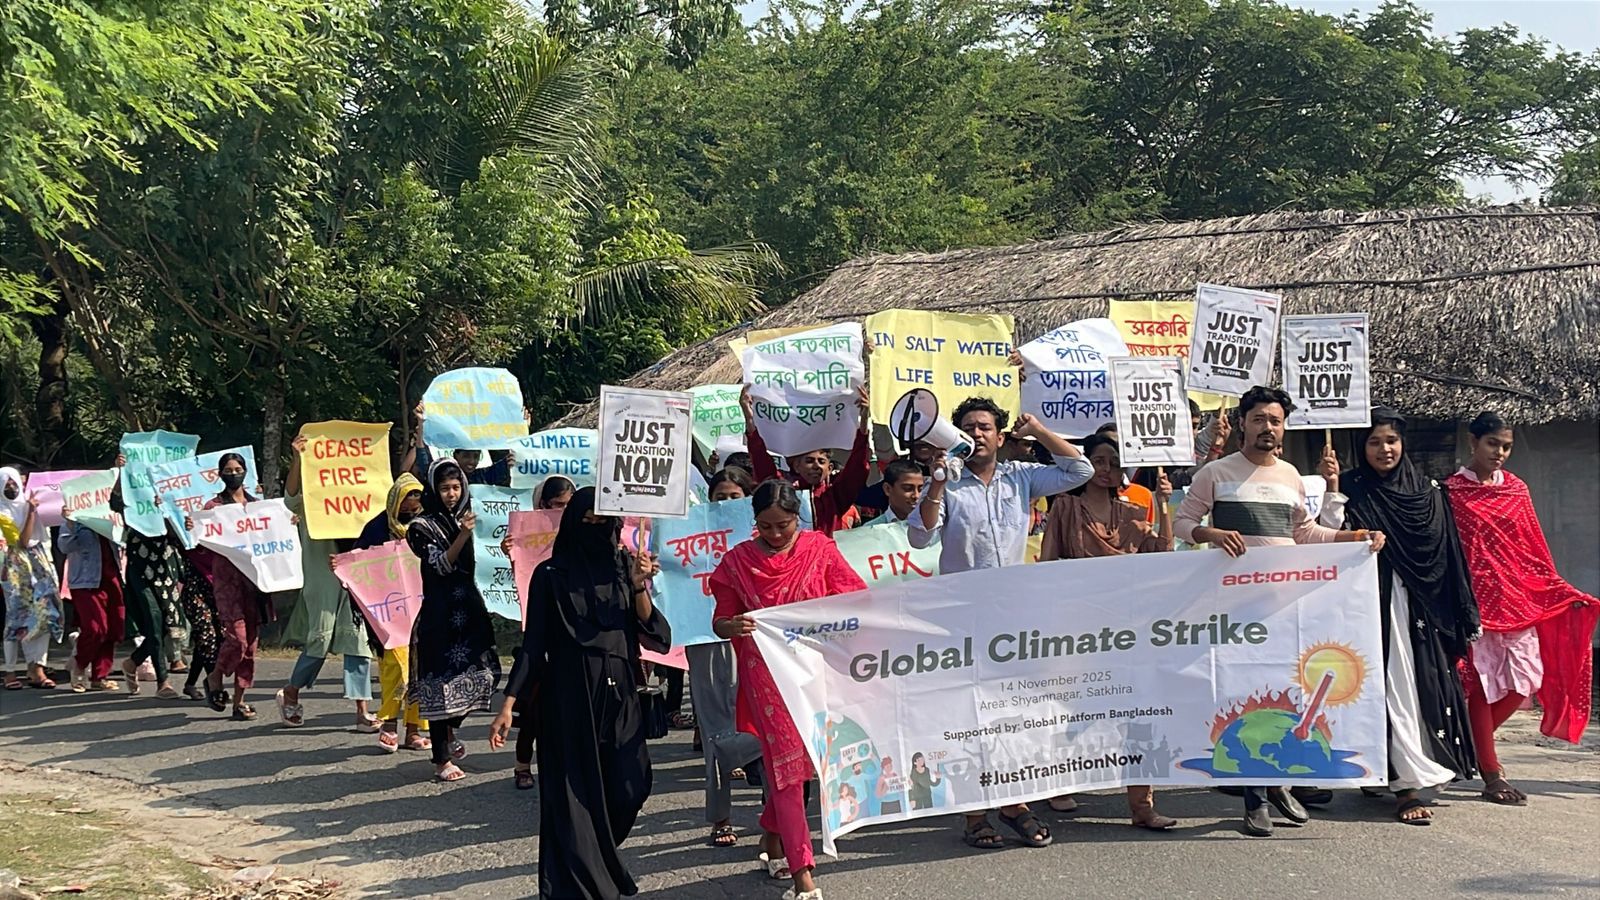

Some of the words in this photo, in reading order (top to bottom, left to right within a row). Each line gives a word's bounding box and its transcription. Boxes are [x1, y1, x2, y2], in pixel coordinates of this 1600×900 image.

[1208, 312, 1262, 336] JUST
[874, 332, 895, 348] IN
[905, 336, 946, 352] SALT
[1207, 332, 1260, 346] TRANSITION
[1203, 341, 1258, 370] NOW
[1298, 341, 1352, 363] JUST
[803, 362, 850, 390] পানি
[896, 367, 934, 384] LIFE
[953, 372, 1012, 387] BURNS
[1299, 364, 1353, 373] TRANSITION
[1040, 370, 1107, 390] আমার
[1299, 373, 1352, 398] NOW
[1128, 382, 1173, 402] JUST
[796, 404, 831, 426] হবে
[1041, 392, 1114, 420] অধিকার
[1129, 403, 1177, 412] TRANSITION
[615, 419, 675, 446] JUST
[1131, 413, 1176, 436] NOW
[126, 448, 144, 463] PAY
[147, 448, 160, 462] UP
[314, 437, 373, 460] CEASE
[616, 444, 675, 457] TRANSITION
[319, 466, 368, 487] FIRE
[518, 459, 591, 475] JUSTICE
[613, 455, 674, 485] NOW
[324, 494, 371, 515] NOW
[204, 523, 222, 537] IN
[236, 517, 271, 533] SALT
[253, 539, 294, 556] BURNS
[867, 551, 934, 580] FIX
[850, 636, 974, 683] Global
[988, 627, 1137, 663] Climate
[1150, 614, 1268, 647] Strike
[1000, 681, 1014, 693] 14
[1018, 675, 1077, 690] November
[1082, 671, 1112, 683] 2025
[980, 699, 1008, 712] Area:
[1011, 689, 1083, 707] Shyamnagar,
[1086, 684, 1133, 698] Satkhira
[944, 724, 1001, 742] Supported
[1004, 721, 1021, 734] by:
[1024, 716, 1057, 730] Global
[1060, 710, 1106, 724] Platform
[1110, 706, 1173, 720] Bangladesh
[979, 752, 1143, 787] #JustTransitionNow
